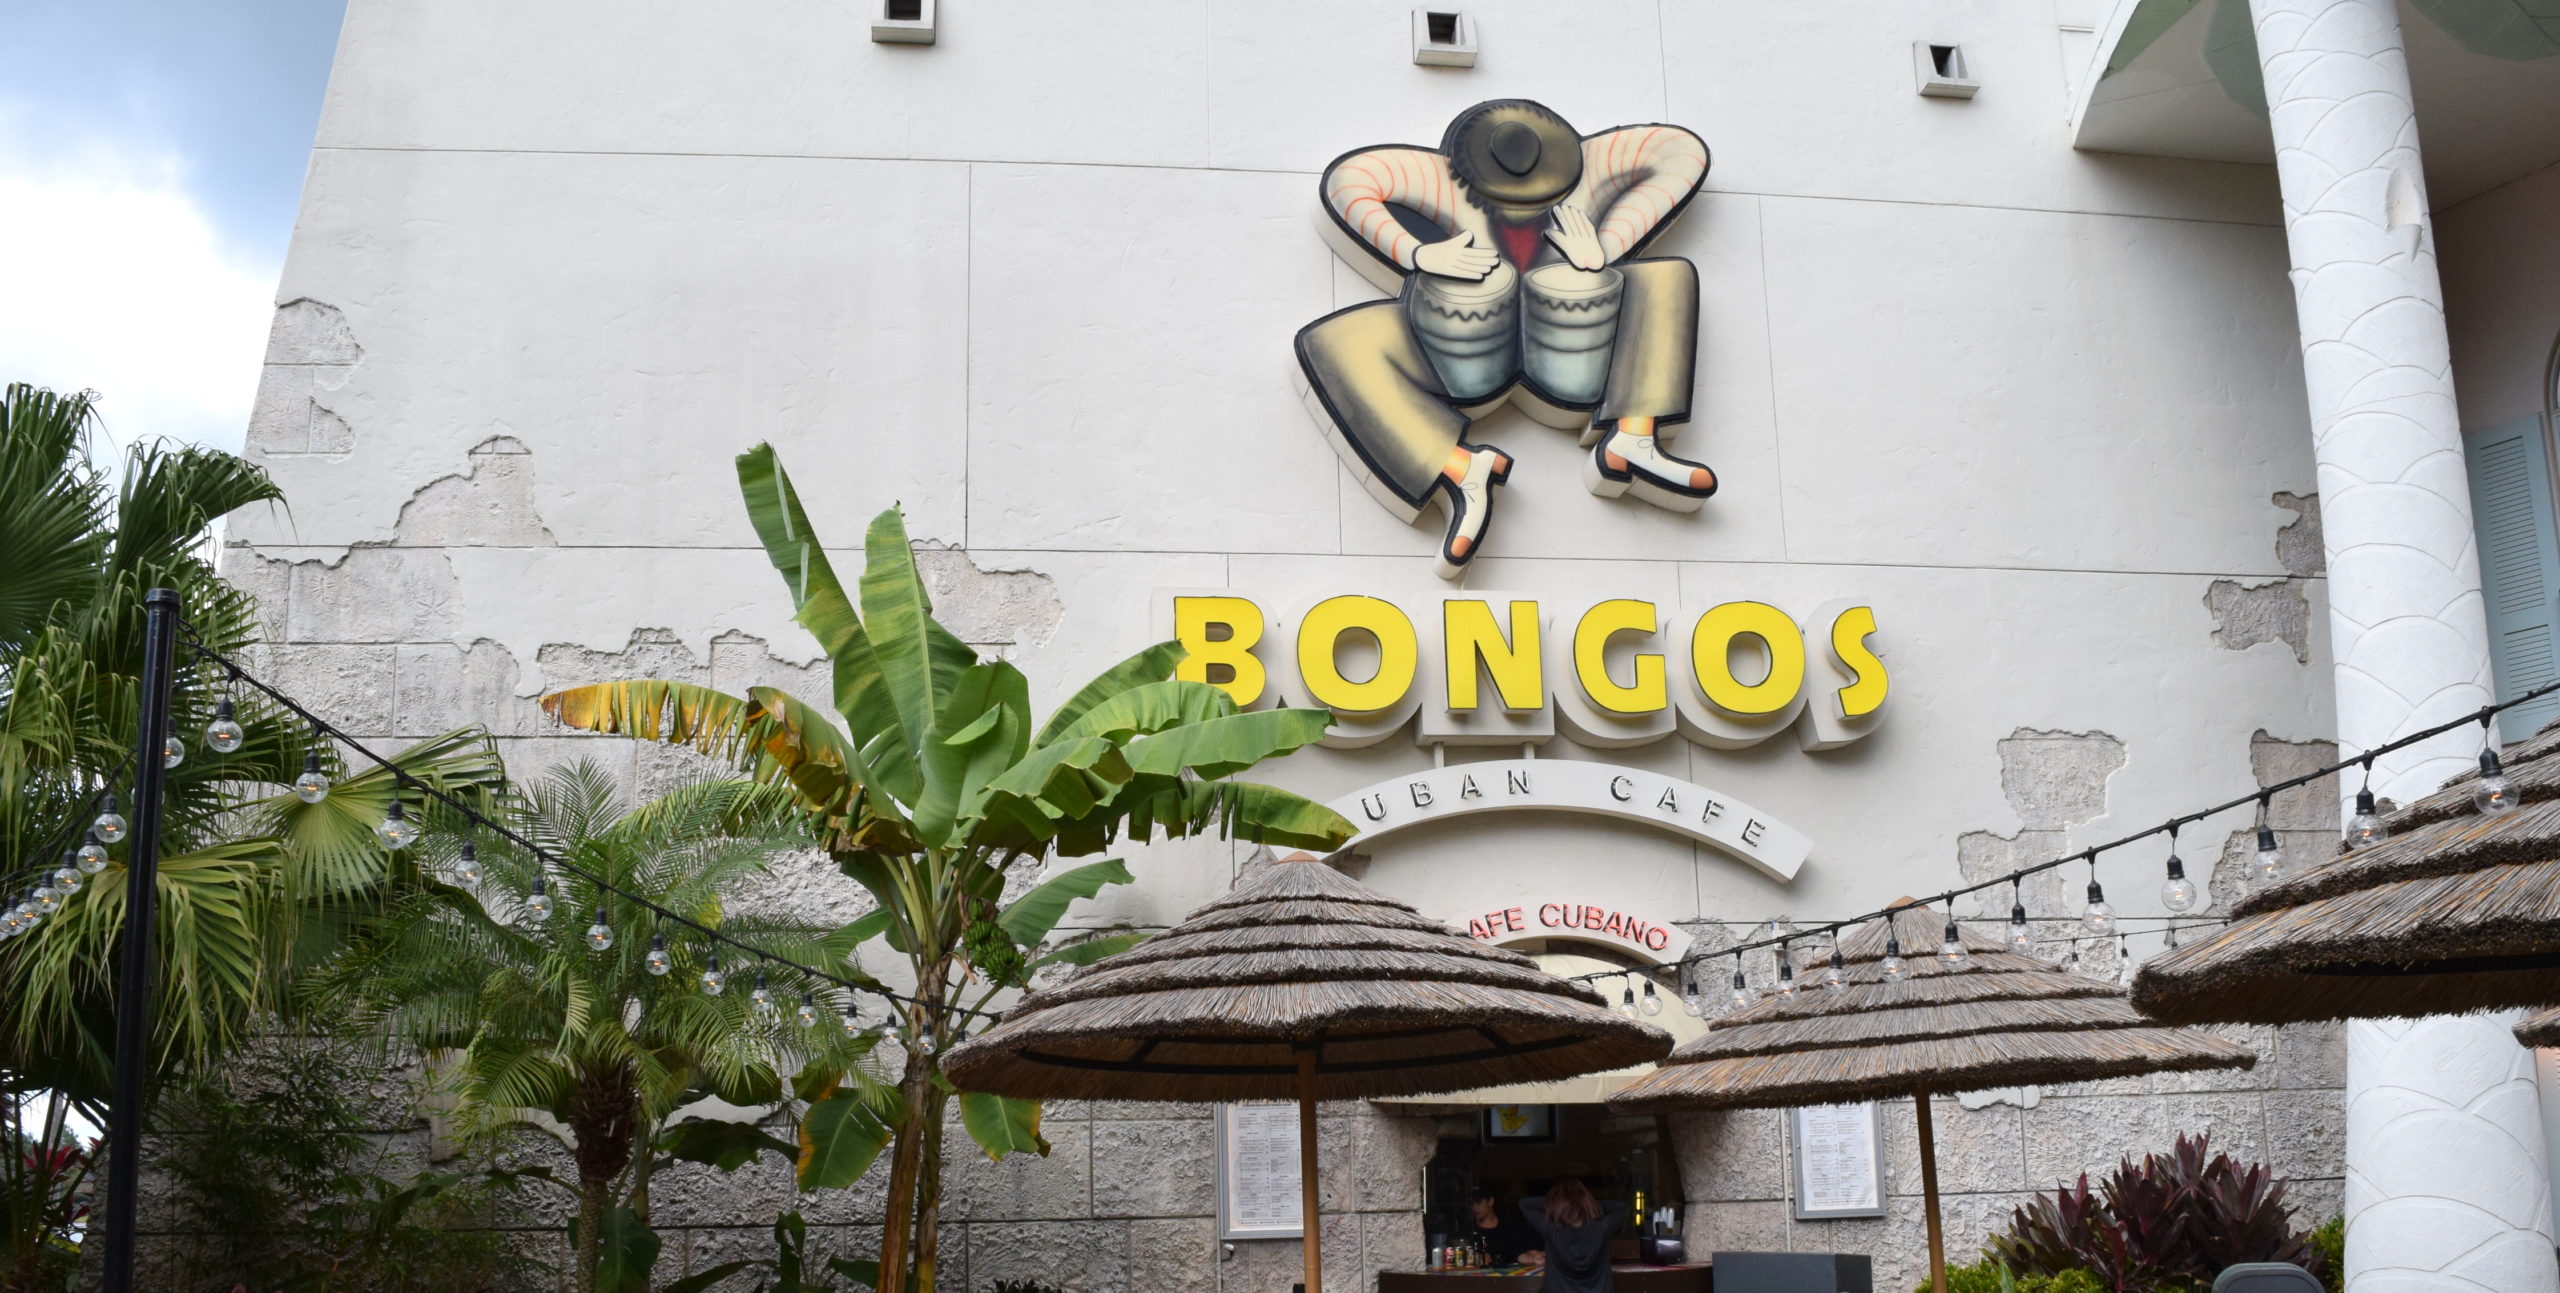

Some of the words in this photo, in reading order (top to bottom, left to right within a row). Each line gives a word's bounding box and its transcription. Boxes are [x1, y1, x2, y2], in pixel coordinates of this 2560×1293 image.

[1173, 595, 1889, 717] BONGOS
[1361, 769, 1531, 821] UBAN
[1610, 775, 1766, 848] CAFE
[1469, 906, 1525, 940] AFE
[1539, 903, 1670, 950] CUBANO
